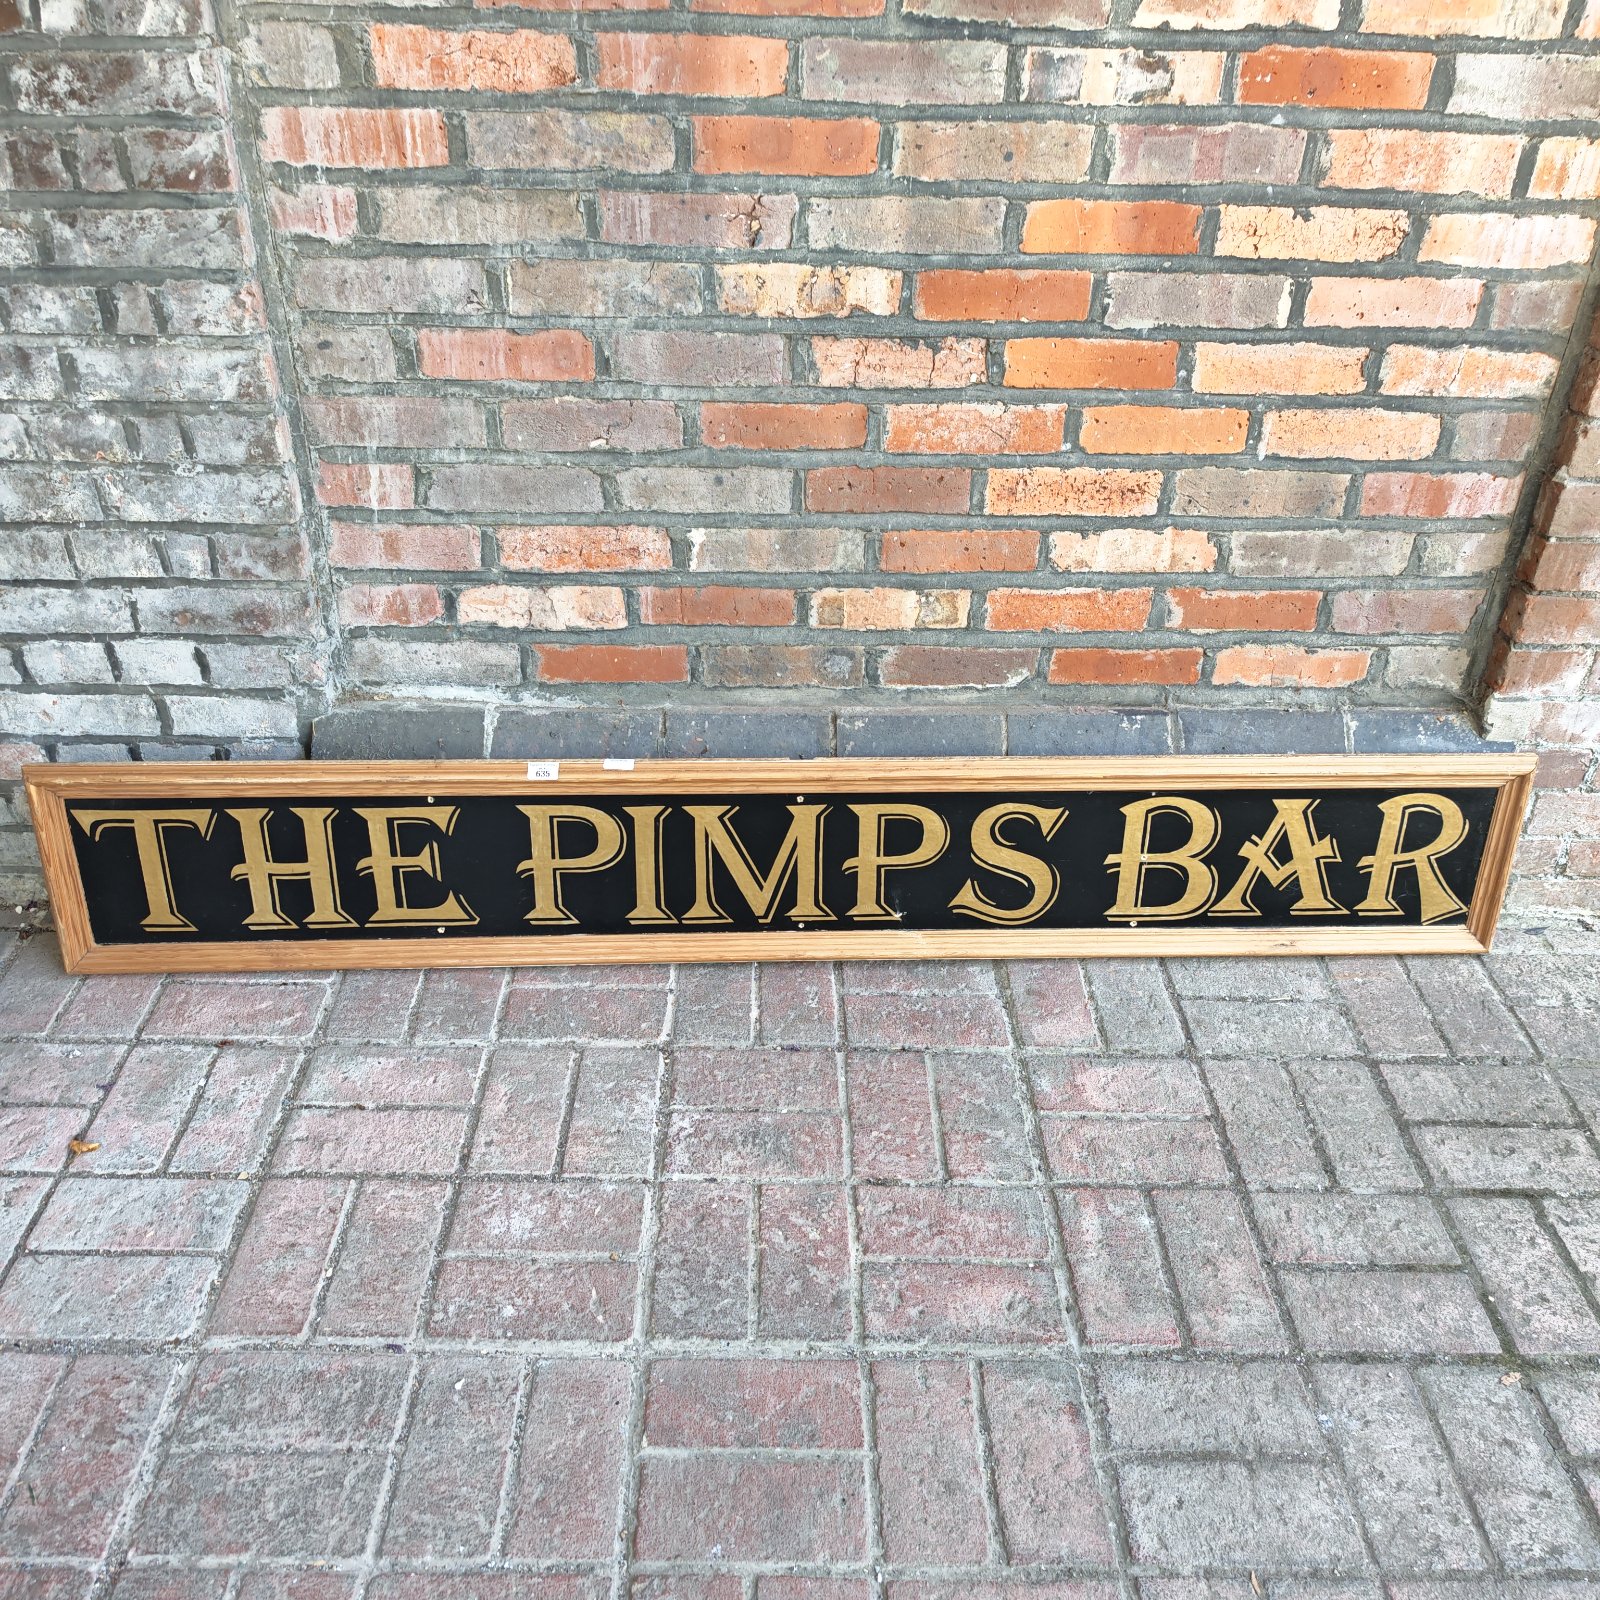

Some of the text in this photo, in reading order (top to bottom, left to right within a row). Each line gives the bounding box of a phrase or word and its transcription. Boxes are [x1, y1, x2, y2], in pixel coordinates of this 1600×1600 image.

[535, 770, 550, 778] 635
[69, 792, 1470, 932] THE PIMPS BAR
